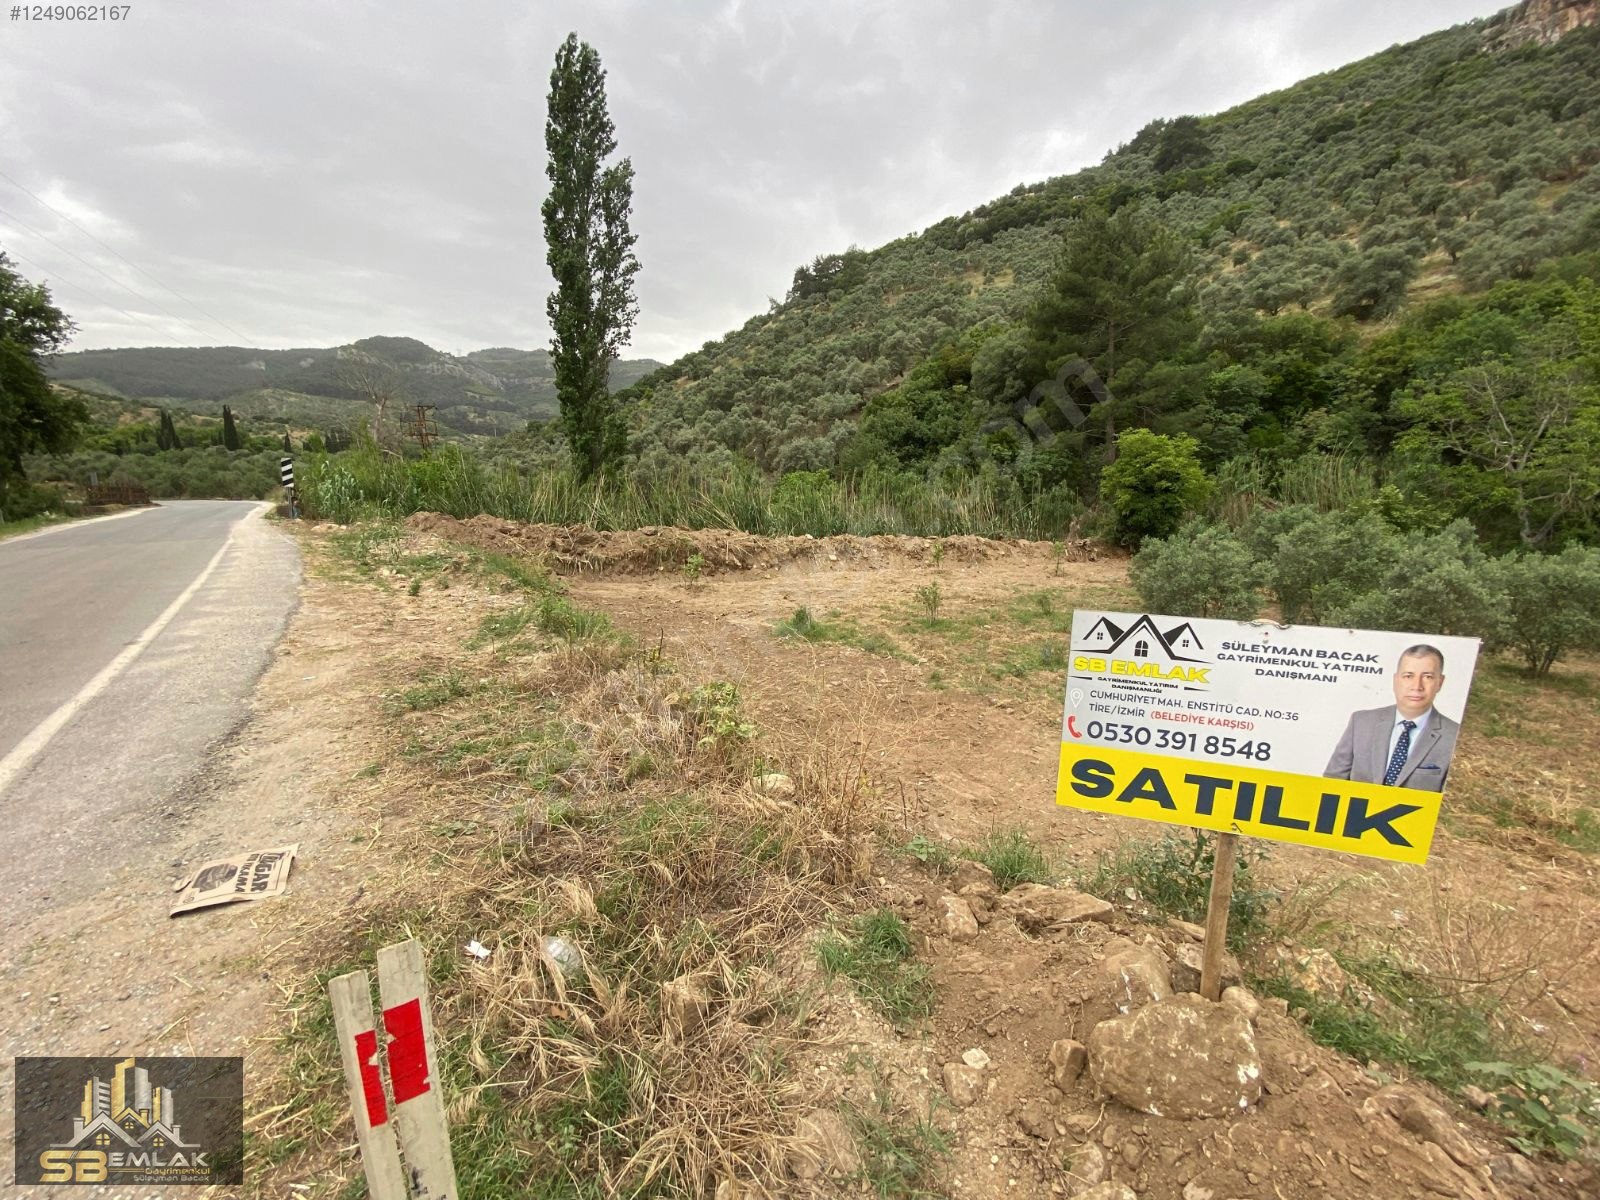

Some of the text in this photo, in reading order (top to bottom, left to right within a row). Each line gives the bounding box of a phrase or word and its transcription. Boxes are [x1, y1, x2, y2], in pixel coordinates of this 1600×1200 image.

[1221, 640, 1379, 663] SÜLEYMAN BACAK
[1074, 656, 1212, 684] SB EMLAK
[1217, 652, 1383, 675] GAYRİMENKUL YATIRIM
[1097, 677, 1147, 686] GAYRİMENKUL
[1255, 668, 1338, 683] DANIŞMANI
[1090, 690, 1299, 721] CUMHURİYET MAH. ENSTİTÜ CAD. NO:36
[1151, 710, 1205, 725] (BELEDİYE
[1207, 717, 1254, 732] KARŞISI)
[1086, 720, 1271, 762] 0530 391 8548
[1070, 758, 1424, 849] SATILIK
